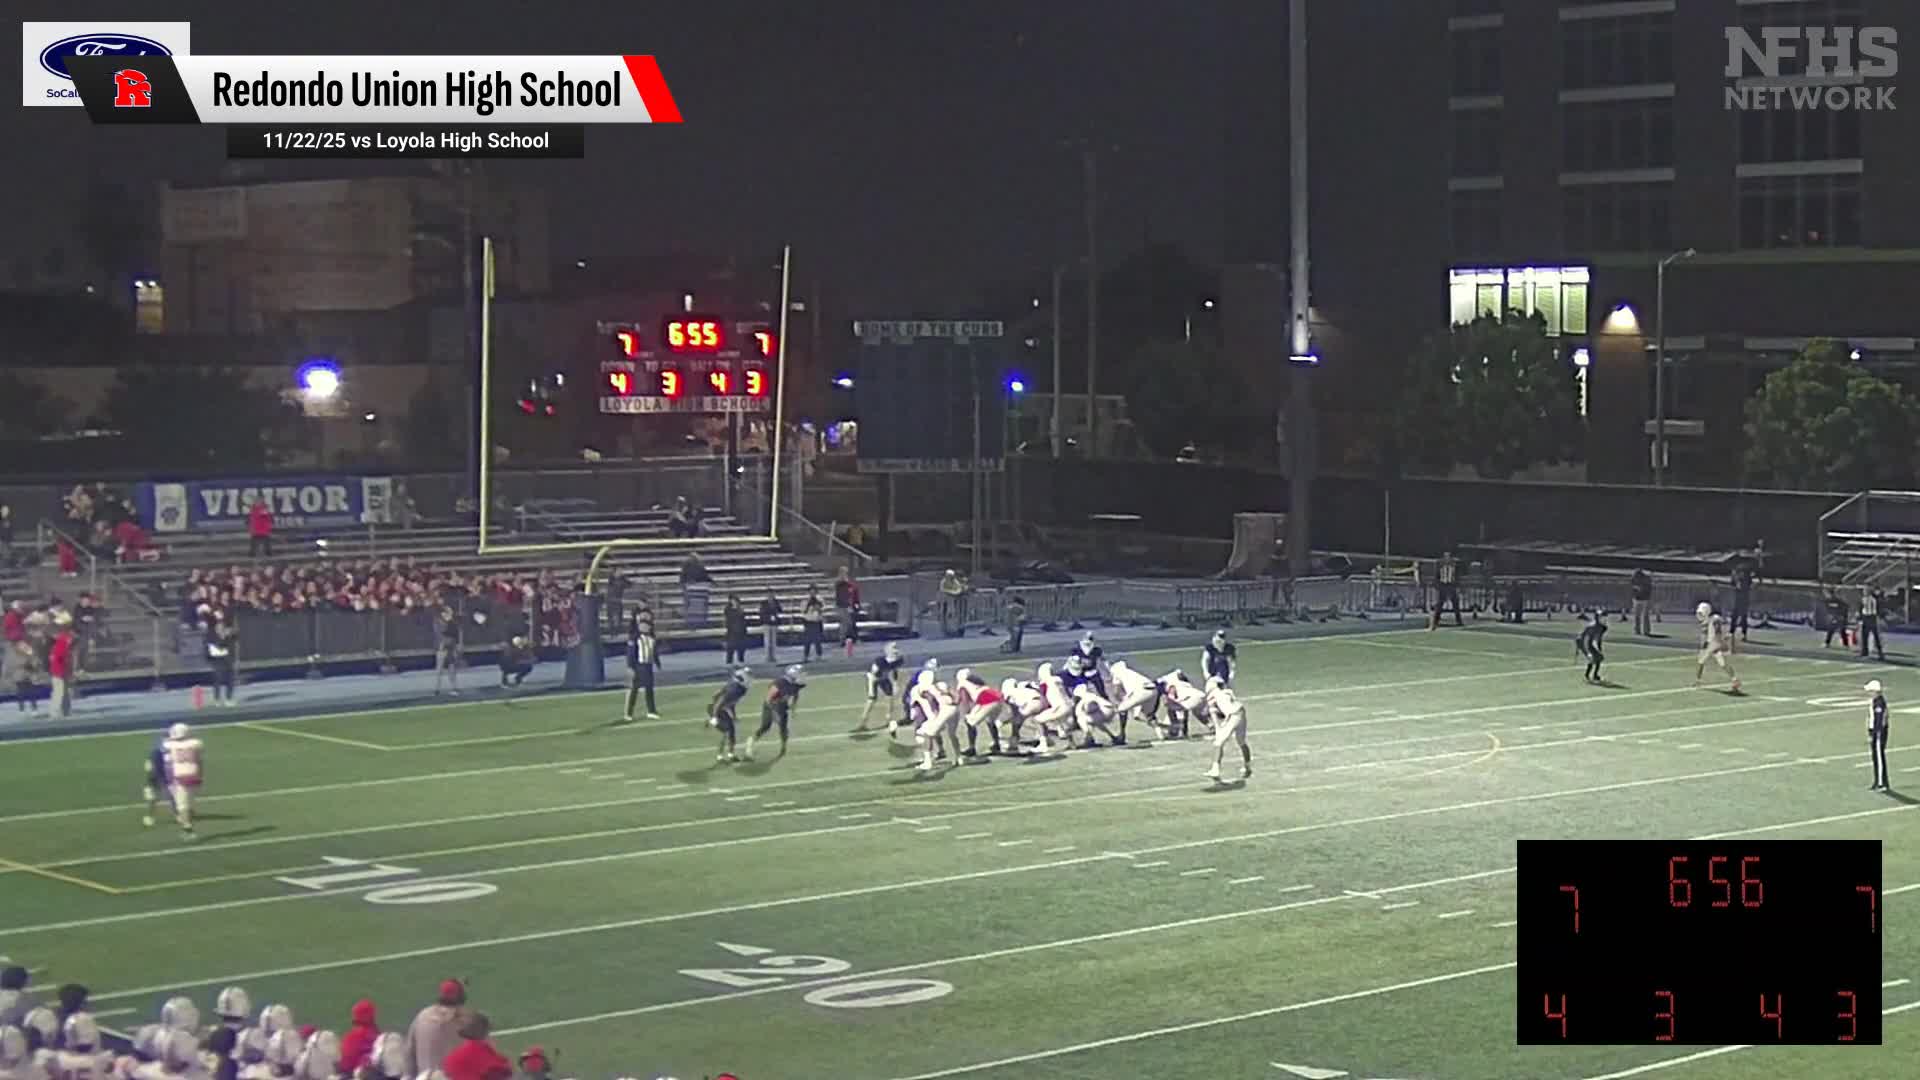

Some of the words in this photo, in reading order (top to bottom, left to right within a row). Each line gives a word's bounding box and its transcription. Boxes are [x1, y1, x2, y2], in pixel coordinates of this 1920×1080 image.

[617, 332, 634, 355] 7
[667, 322, 718, 347] 655
[754, 331, 771, 355] 7
[610, 373, 628, 393] 4
[661, 371, 678, 395] 3
[710, 372, 727, 393] 4
[746, 370, 762, 394] 3
[603, 397, 663, 412] LOYOLA
[200, 485, 349, 516] VISITOR
[676, 955, 953, 1008] 20
